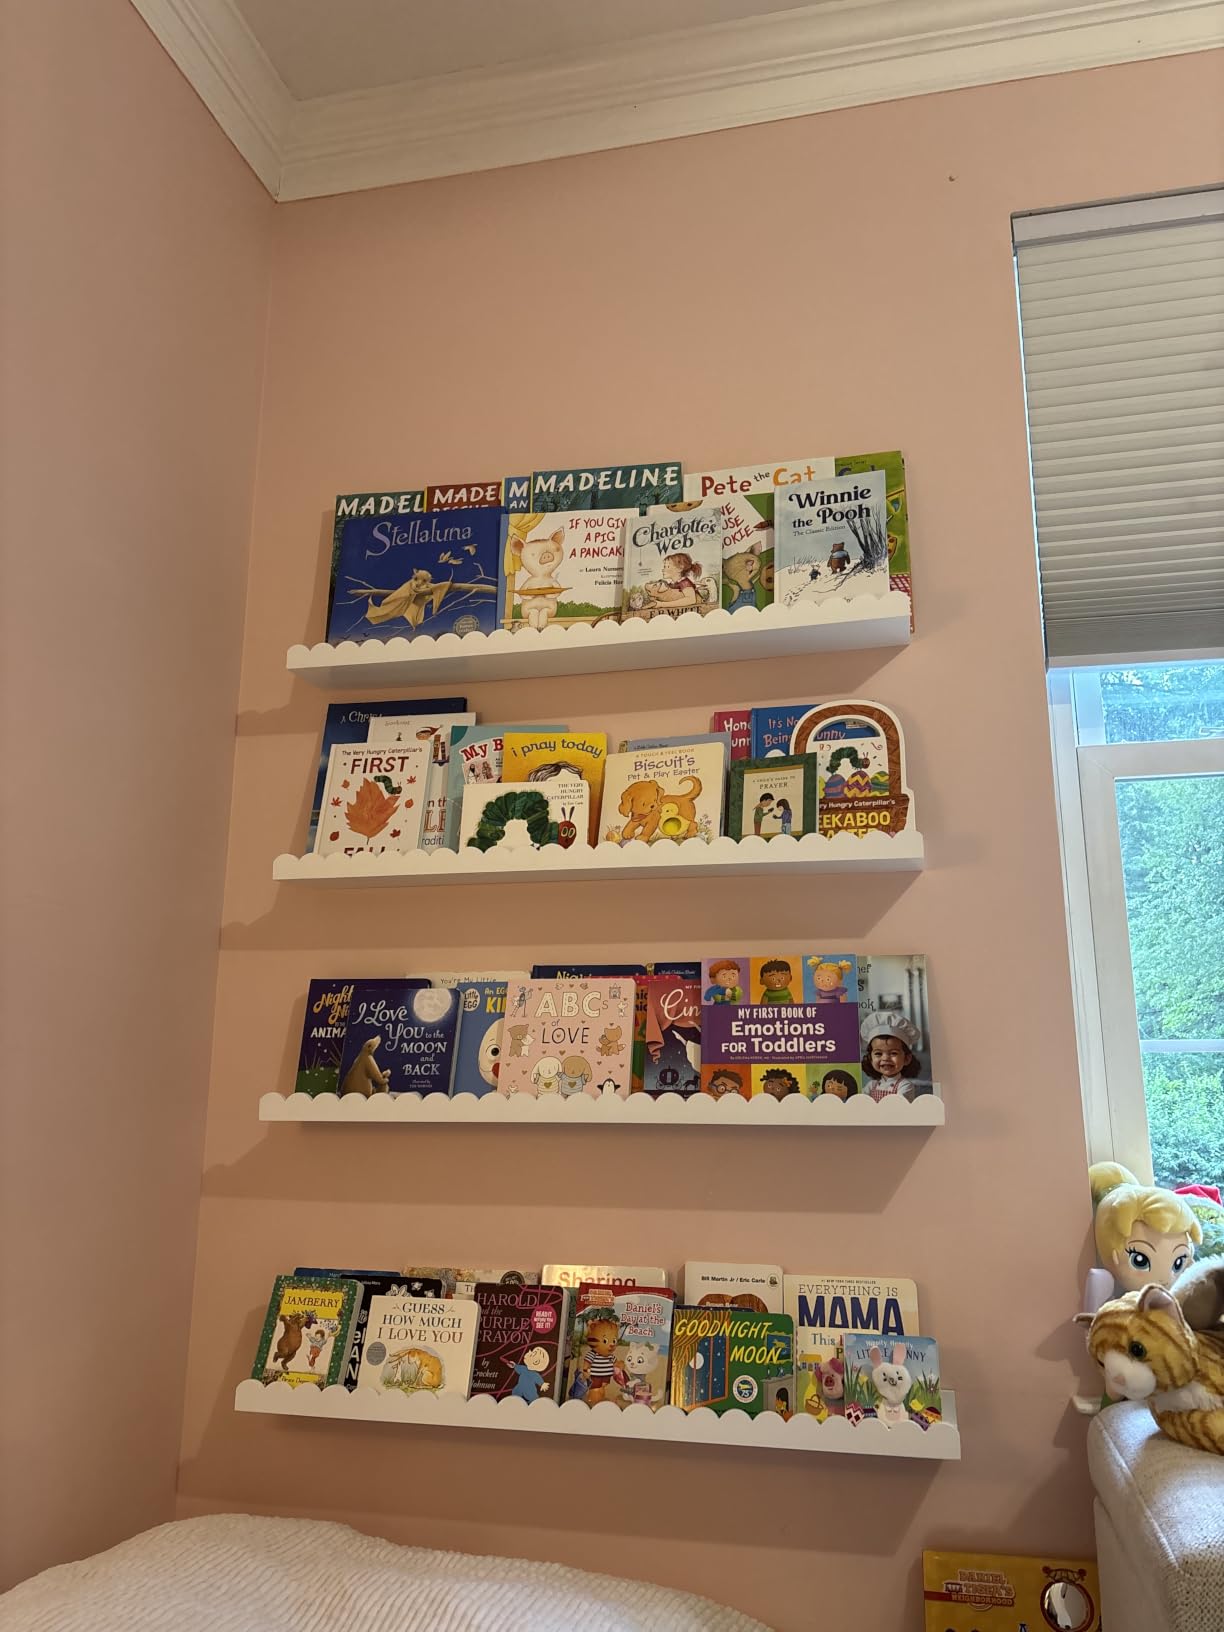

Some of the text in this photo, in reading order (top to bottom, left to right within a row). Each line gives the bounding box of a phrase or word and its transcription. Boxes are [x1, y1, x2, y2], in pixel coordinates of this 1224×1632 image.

[534, 466, 679, 494] MADELINE
[701, 475, 752, 497] Pete
[753, 471, 770, 482] the
[773, 466, 816, 487] Cat
[788, 485, 872, 509] Winnie
[569, 518, 581, 530] IF
[584, 517, 604, 529] YOU
[792, 504, 871, 529] the Pooh
[365, 518, 472, 560] Stellaluna
[584, 531, 616, 544] A PIG
[632, 517, 717, 548] Charlotte's
[569, 548, 577, 559] A
[768, 718, 783, 730] It's
[460, 744, 488, 761] My
[511, 738, 603, 759] i pray today
[350, 756, 410, 774] FIRST
[634, 754, 696, 772] Biscuit's
[627, 772, 641, 781] Pet
[653, 770, 670, 779] Play
[673, 767, 700, 776] Easter
[759, 781, 788, 790] PRAYER
[828, 801, 853, 809] Hungry
[853, 799, 896, 807] Caterpillar's
[464, 999, 478, 1009] EGG
[364, 1000, 409, 1026] Love
[738, 1007, 817, 1019] MY FIRST BOOK OF
[551, 1019, 560, 1027] of
[731, 1020, 825, 1036] Emotions
[433, 1030, 445, 1038] the
[541, 1026, 589, 1045] LOVE
[401, 1042, 448, 1053] MOON
[721, 1037, 836, 1054] FOR Toddlers
[419, 1053, 435, 1062] and
[402, 1064, 440, 1076] BACK
[798, 1284, 898, 1297] EVERYTHING IS
[284, 1295, 341, 1308] JAMBERRY
[477, 1292, 538, 1307] HAROLD
[402, 1302, 445, 1314] GUESS
[626, 1302, 663, 1314] Daniel's
[383, 1314, 462, 1328] HOW MUCH
[621, 1314, 665, 1325] Day at the
[798, 1295, 905, 1336] MAMA
[377, 1327, 463, 1343] I LOVE YOU
[628, 1325, 655, 1336] Beach
[674, 1318, 773, 1339] GOODNIGHT
[480, 1329, 533, 1344] RAYON
[811, 1333, 835, 1346] This
[729, 1345, 782, 1364] MOON
[481, 1357, 490, 1369] by
